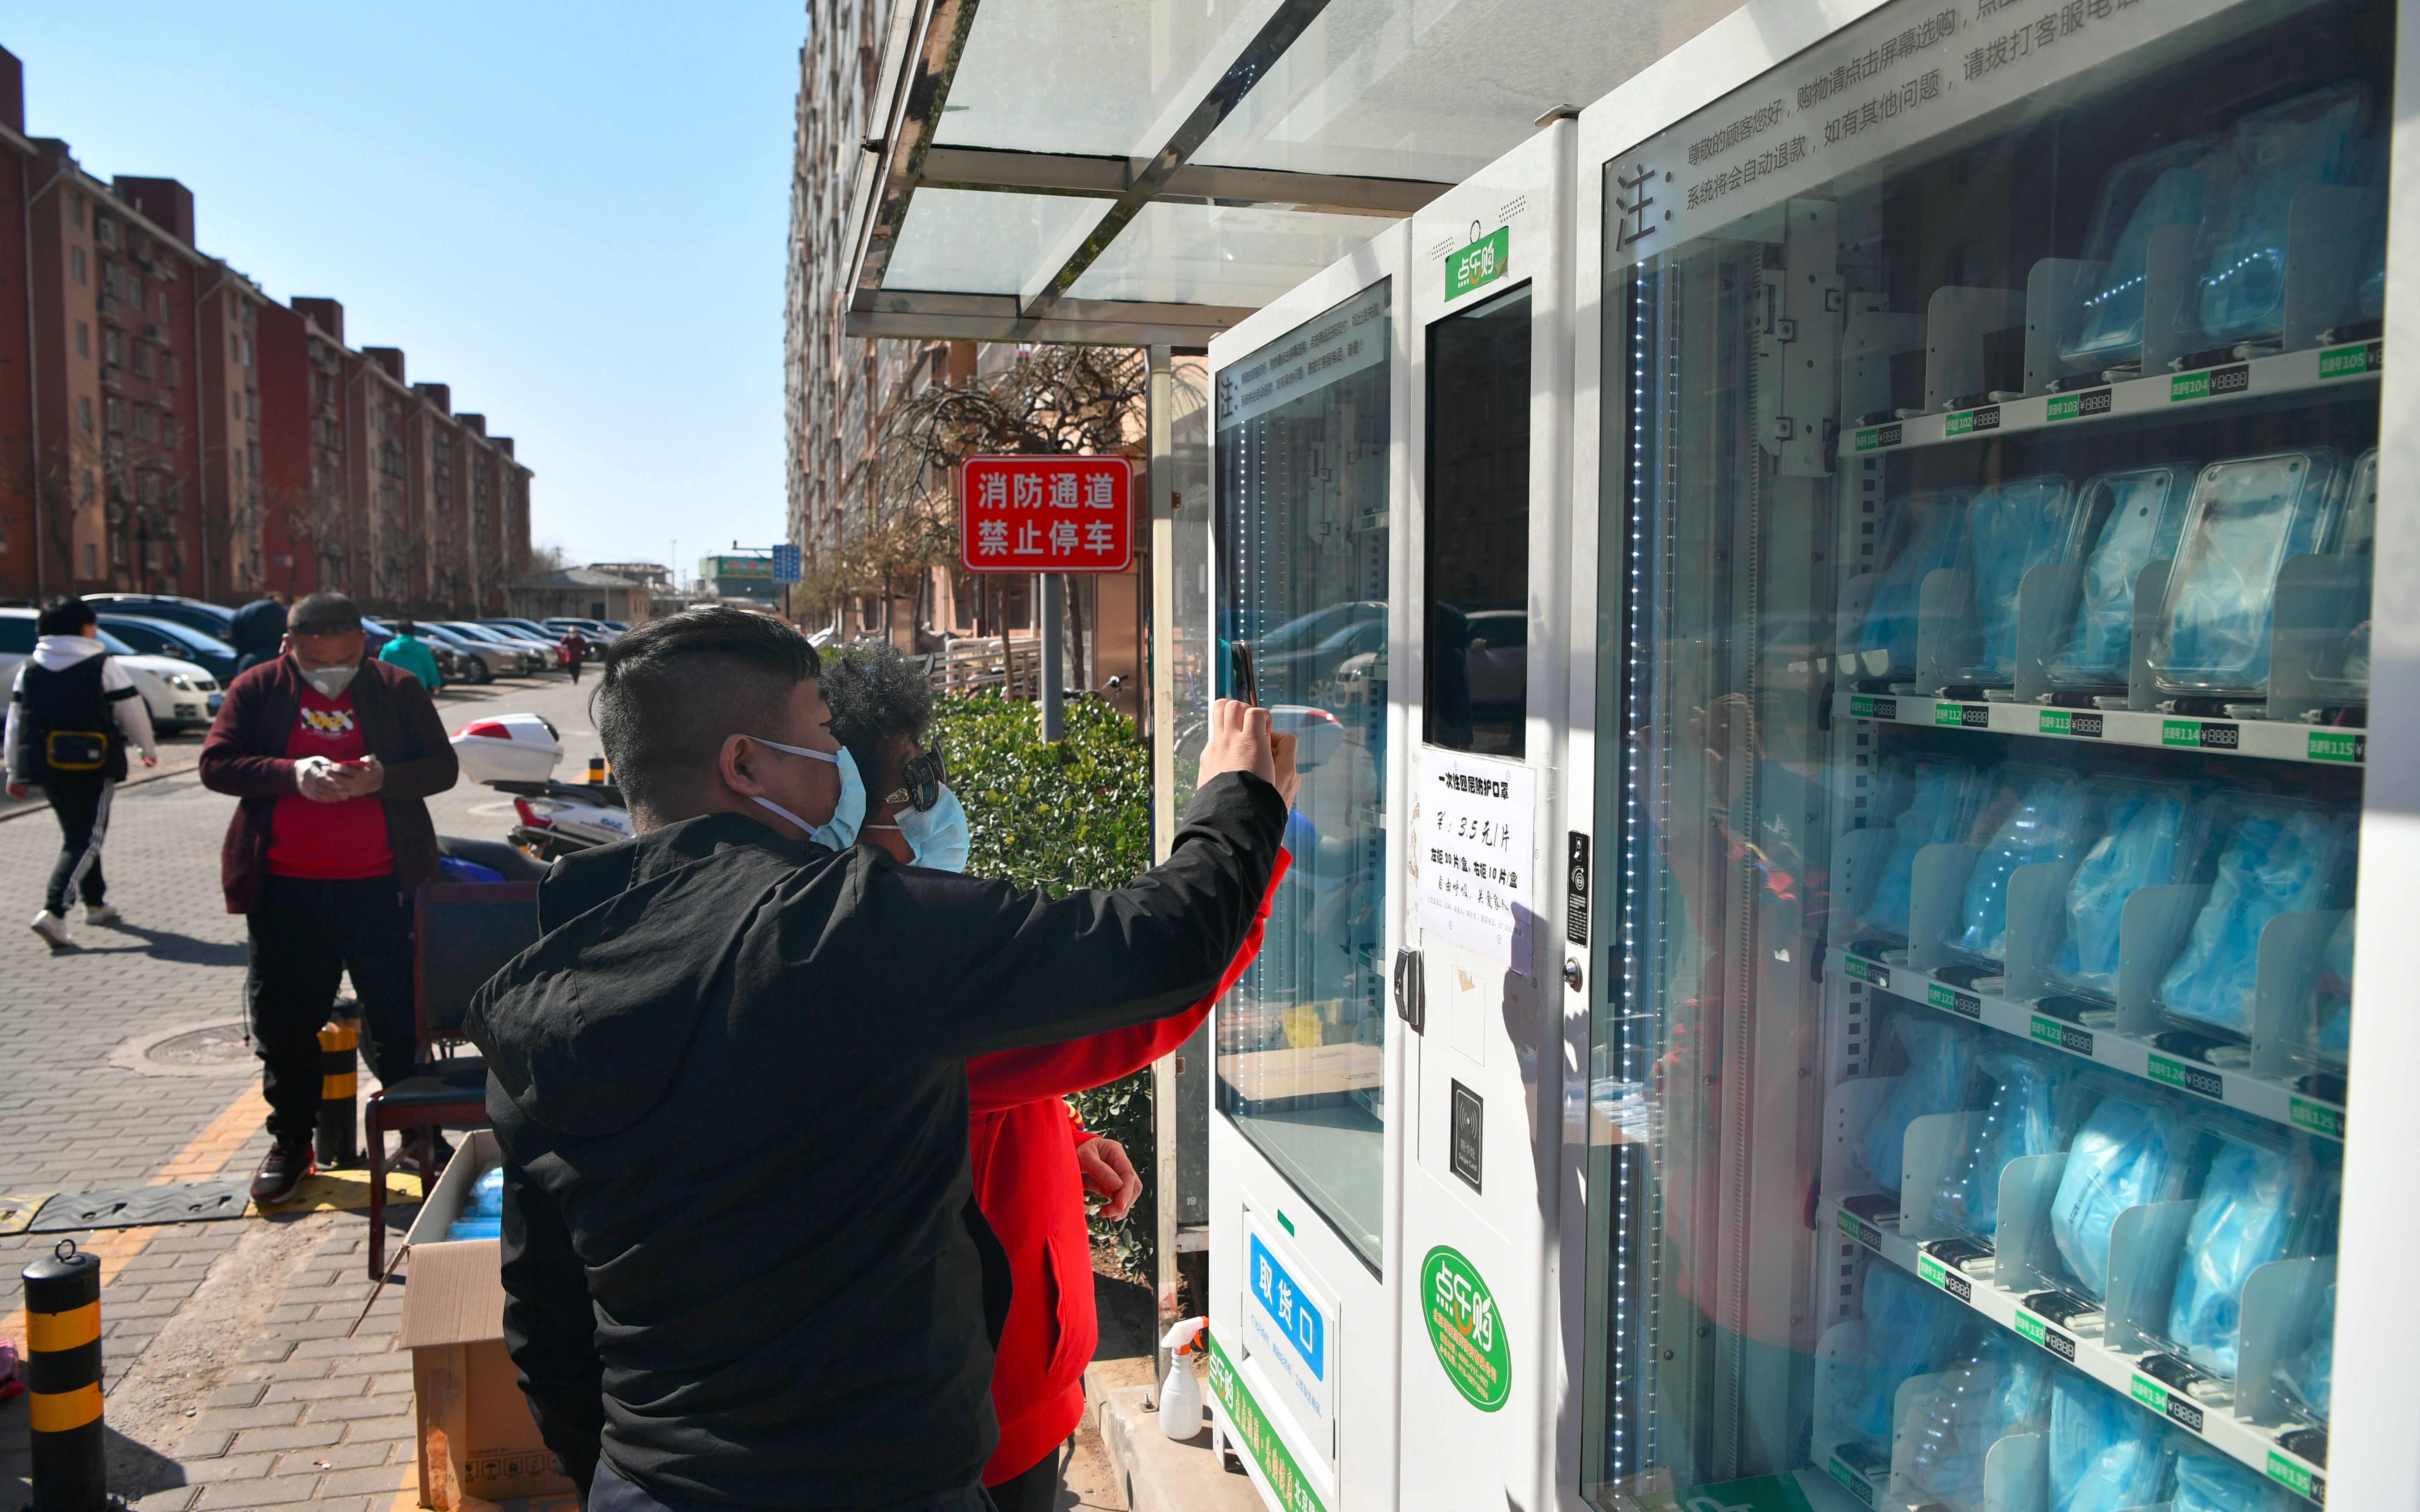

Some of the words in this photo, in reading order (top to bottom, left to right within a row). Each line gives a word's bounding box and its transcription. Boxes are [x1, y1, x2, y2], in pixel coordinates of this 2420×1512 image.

[978, 472, 1114, 509] 消防通道
[978, 519, 1114, 556] 禁止停车
[1439, 772, 1509, 800] 一次性四层防护口罩
[1459, 1153, 1468, 1165] Swipe
[1461, 1139, 1475, 1160] 刷卡处
[1260, 1254, 1313, 1354] 取货口
